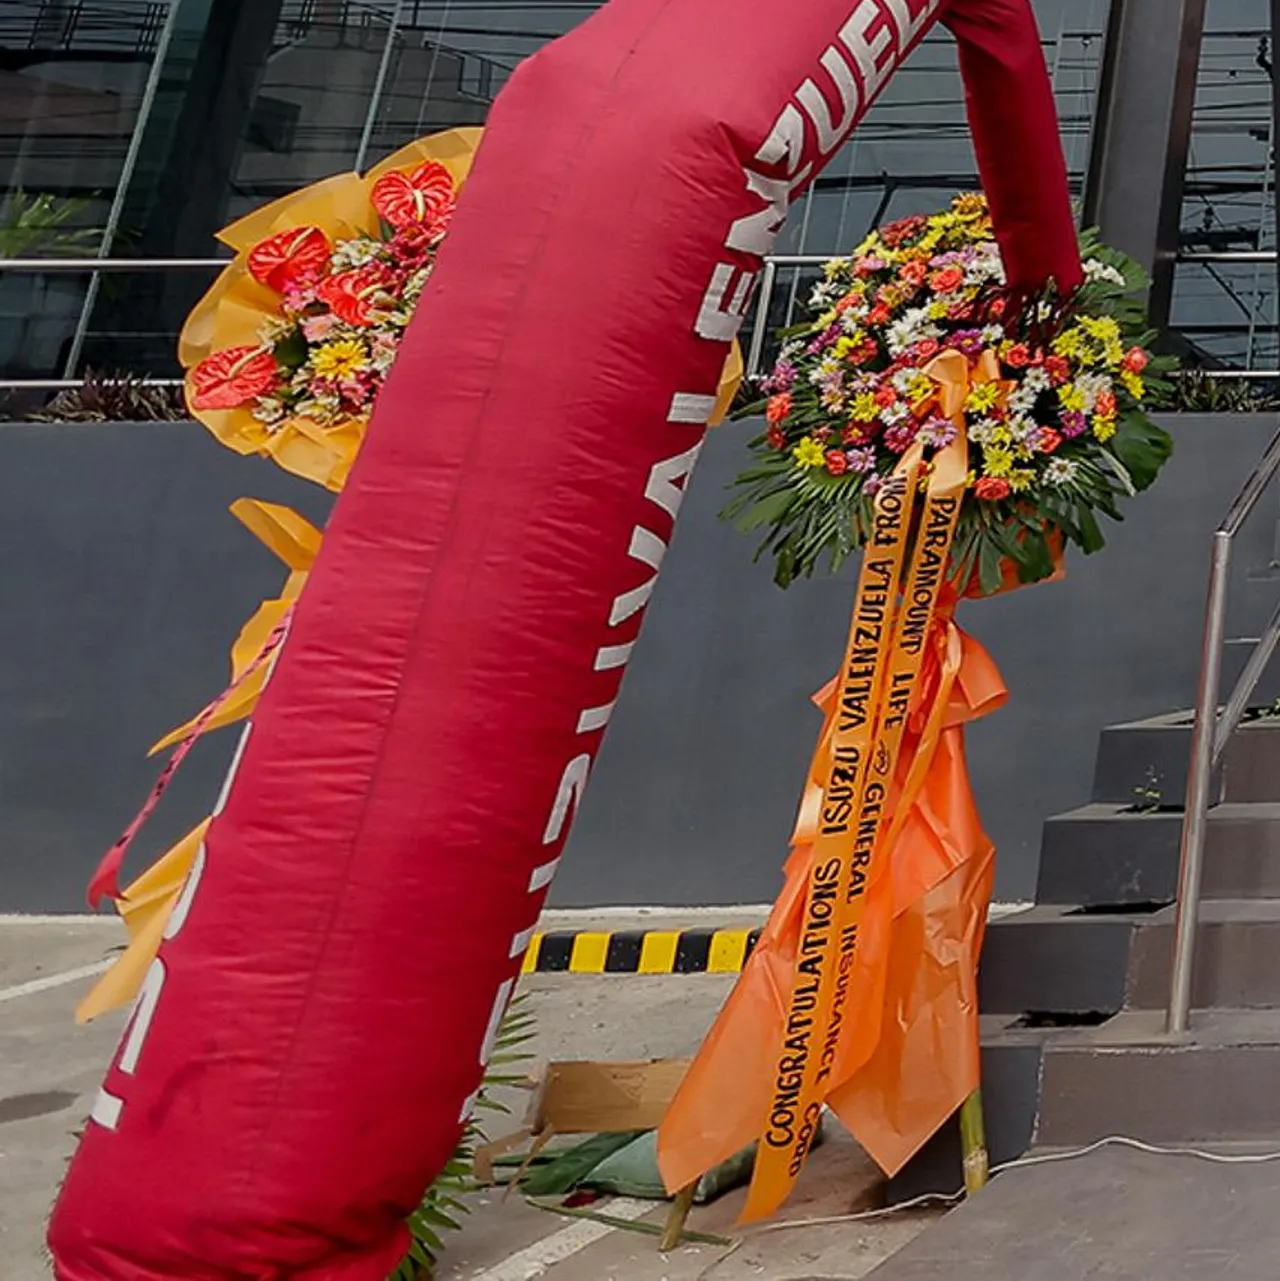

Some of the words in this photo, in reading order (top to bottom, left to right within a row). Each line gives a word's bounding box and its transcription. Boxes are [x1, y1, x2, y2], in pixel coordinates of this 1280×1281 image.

[874, 471, 907, 546] FROM
[901, 496, 957, 655] PARAMOUNT
[838, 557, 894, 733] VALENZUELA
[883, 672, 917, 731] LIFE
[822, 745, 861, 836] ISUZU
[844, 778, 886, 905] GENERAL
[766, 857, 841, 1148] CONGRATULATIONS
